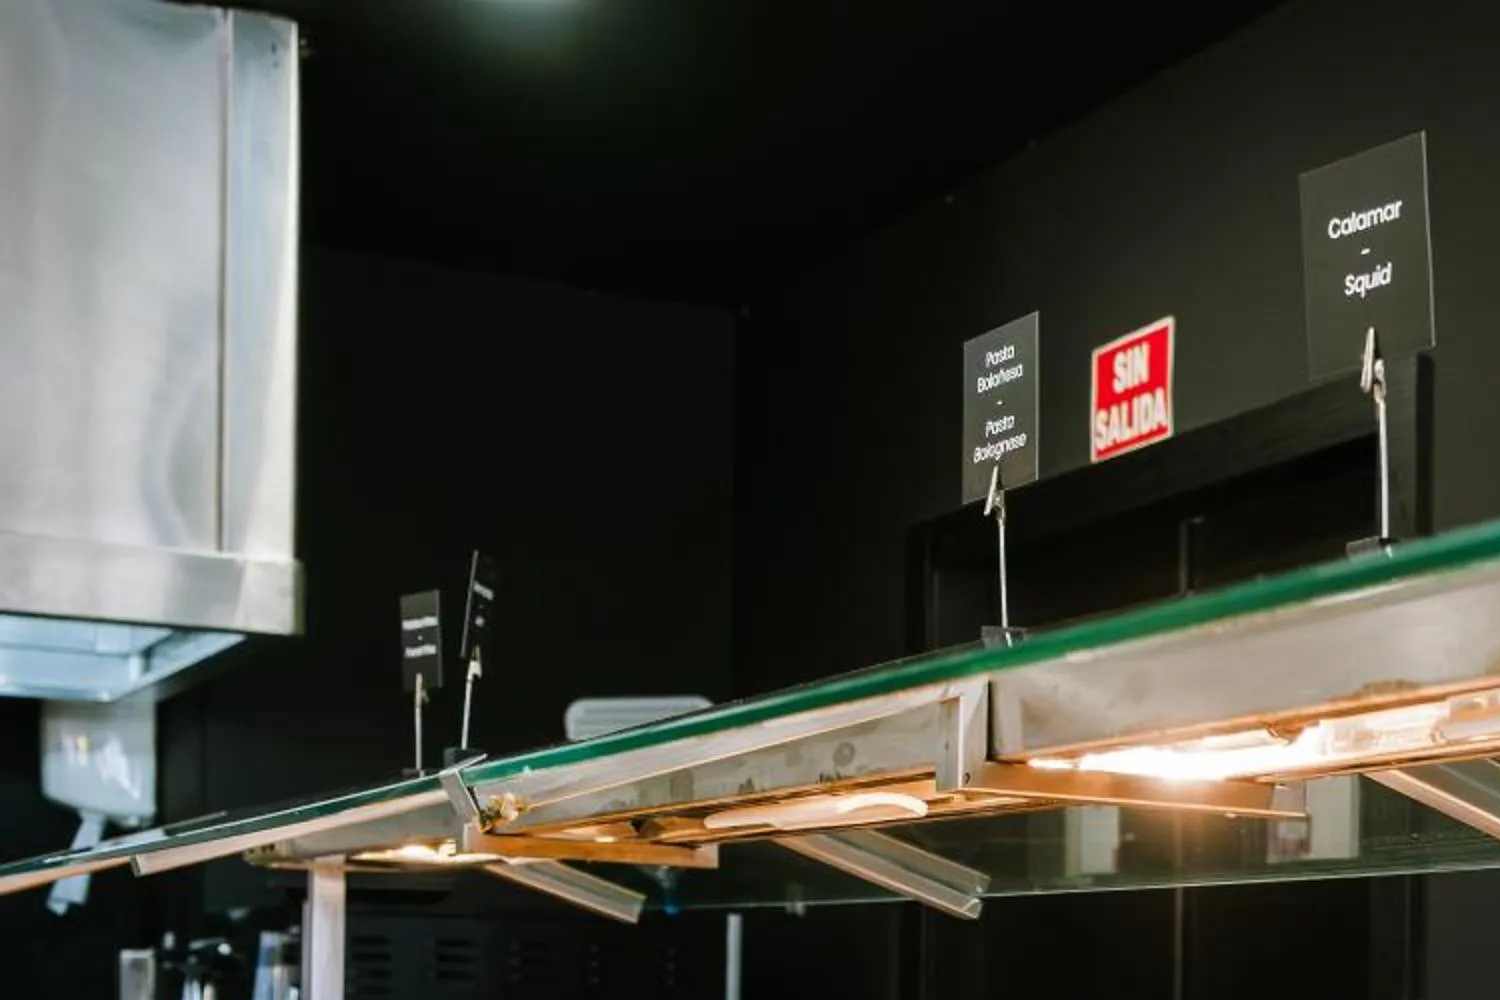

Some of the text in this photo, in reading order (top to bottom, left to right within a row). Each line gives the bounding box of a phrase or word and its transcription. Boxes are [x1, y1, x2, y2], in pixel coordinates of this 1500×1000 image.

[1327, 199, 1404, 239] Calamar
[1343, 262, 1393, 300] Squid
[985, 344, 1016, 369] Pasta
[1112, 341, 1150, 395] SIN
[985, 415, 1016, 439] Pasta
[1094, 386, 1168, 451] SALIDA
